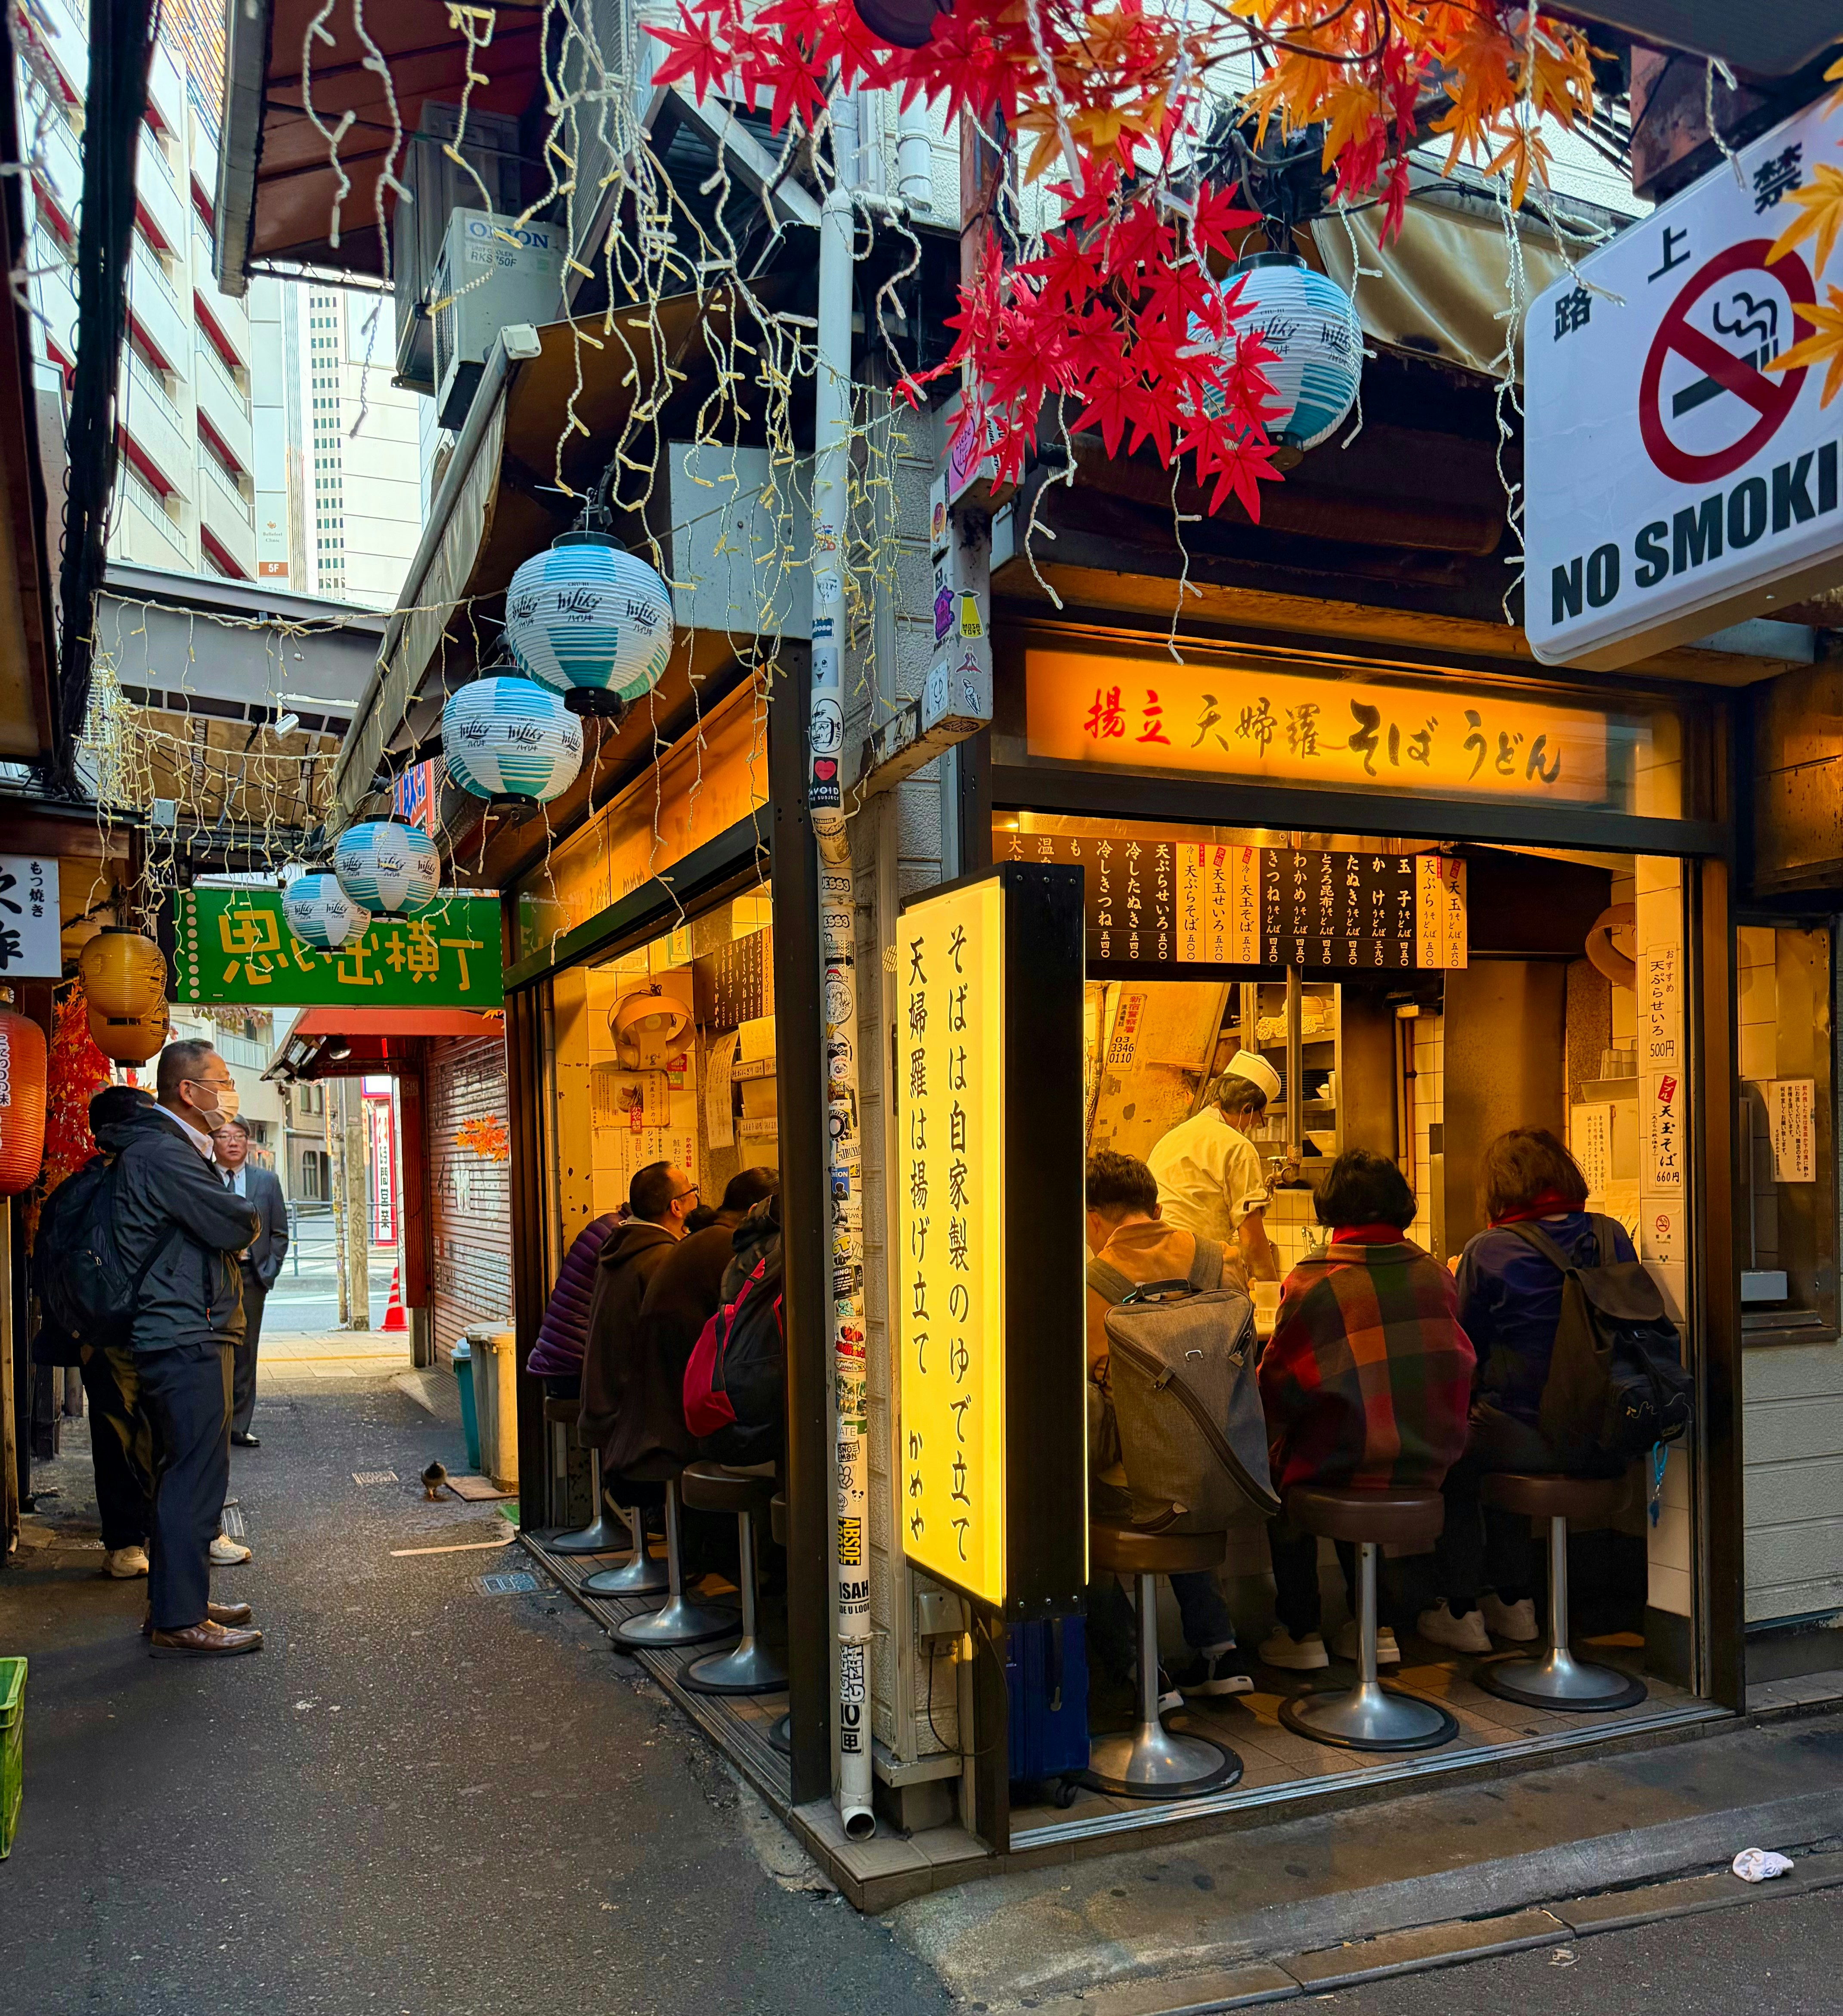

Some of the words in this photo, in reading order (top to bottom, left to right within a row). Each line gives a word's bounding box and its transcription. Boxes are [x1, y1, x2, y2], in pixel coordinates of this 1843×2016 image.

[1552, 543, 1620, 626] NO
[1634, 440, 1839, 589] SMOKI
[568, 614, 594, 622] ハイリキ
[1083, 685, 1172, 746] 揚立
[1189, 692, 1323, 761] 天婦羅
[1347, 698, 1439, 777] そば
[1462, 709, 1563, 785] うどん
[29, 861, 45, 918] もつ焼き
[1096, 839, 1113, 927] 冷しきつね
[1125, 841, 1142, 928] 冷したぬき
[1155, 844, 1171, 930] 天ぷらせいろ
[1183, 845, 1199, 932] 冷し天ぷらそば
[1211, 868, 1227, 931] 天玉せいろ
[1239, 865, 1254, 933] 冷し天玉そば
[1266, 850, 1280, 903] きつね
[1293, 851, 1307, 903] わかめ
[1319, 853, 1335, 908] とろろ昆布
[1346, 854, 1360, 906] たぬき
[1372, 857, 1386, 906] かけ
[1397, 858, 1412, 907] 玉子
[1423, 859, 1437, 908] 天ぷら
[1447, 881, 1462, 912] 天玉
[218, 909, 484, 992] 思い出横丁
[1666, 950, 1674, 992] おすすめ
[1650, 960, 1665, 1036] 天ぷらせいろ
[1109, 1053, 1132, 1063] 0110
[1111, 1043, 1134, 1052] 3346
[1650, 1039, 1674, 1058] 500円
[635, 1138, 643, 1169] 五目いな
[908, 936, 931, 1375] 天婦羅は揚げ立て
[1658, 1104, 1678, 1167] 天玉そば
[1657, 1171, 1680, 1183] 660円
[947, 923, 971, 1562] そばは自家製のゆで立て
[908, 1429, 925, 1542] かめや
[843, 1519, 861, 1565] ABSOE
